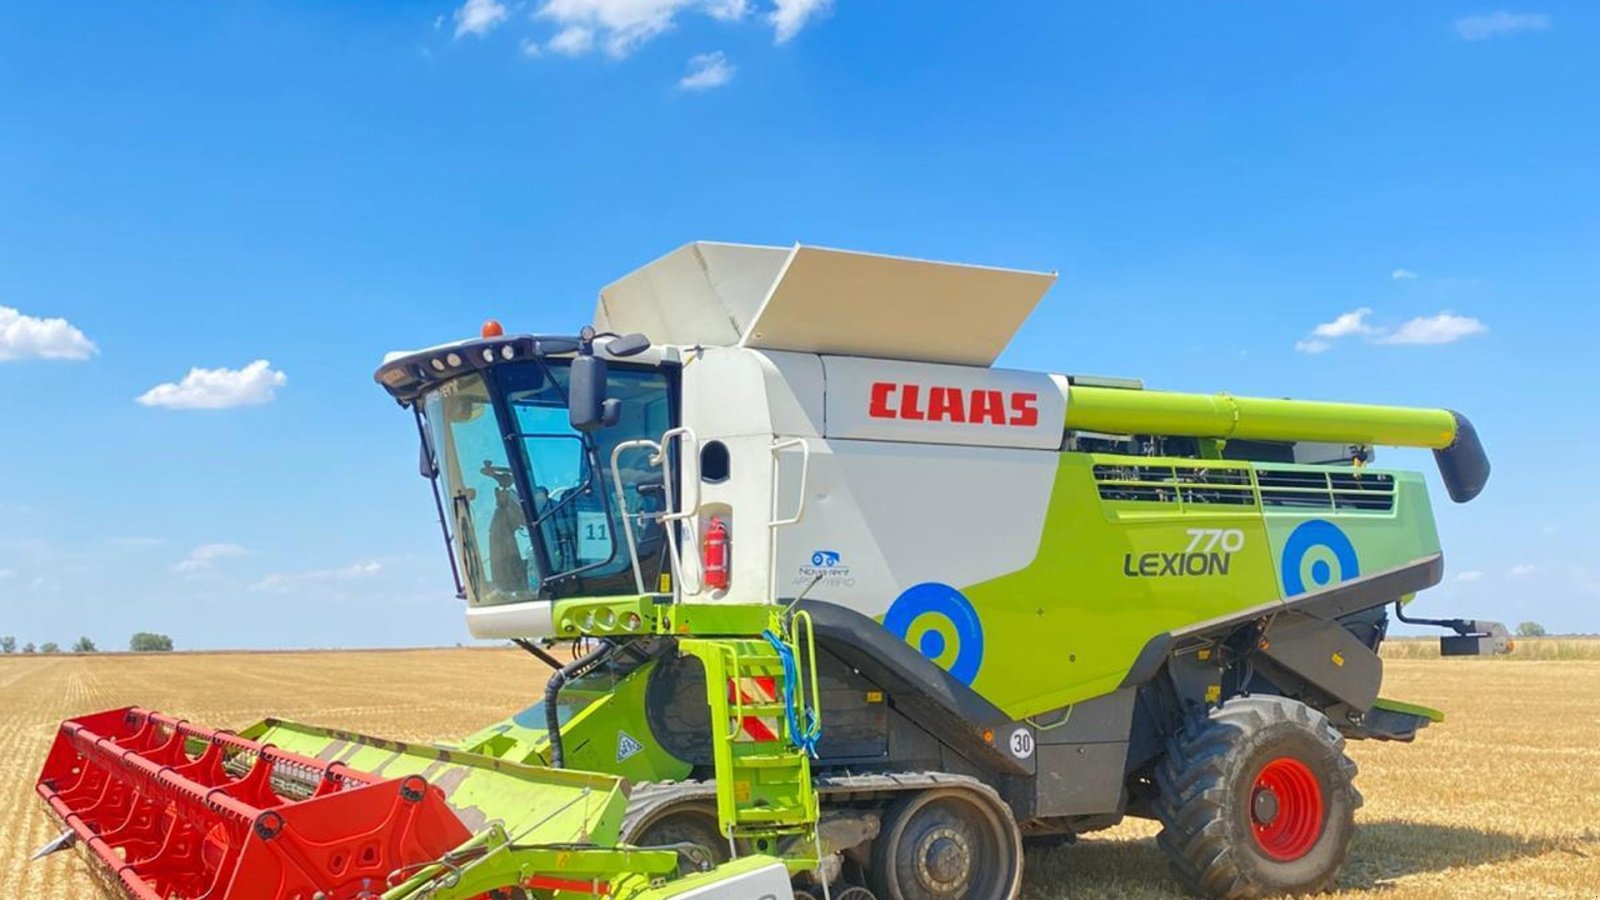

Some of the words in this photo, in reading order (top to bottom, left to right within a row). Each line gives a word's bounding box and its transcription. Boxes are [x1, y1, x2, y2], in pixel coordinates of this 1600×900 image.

[869, 382, 1039, 427] CLAAS
[586, 523, 608, 540] 11
[1186, 528, 1244, 553] 770
[1124, 552, 1231, 577] LEXION
[1014, 734, 1031, 753] 30
